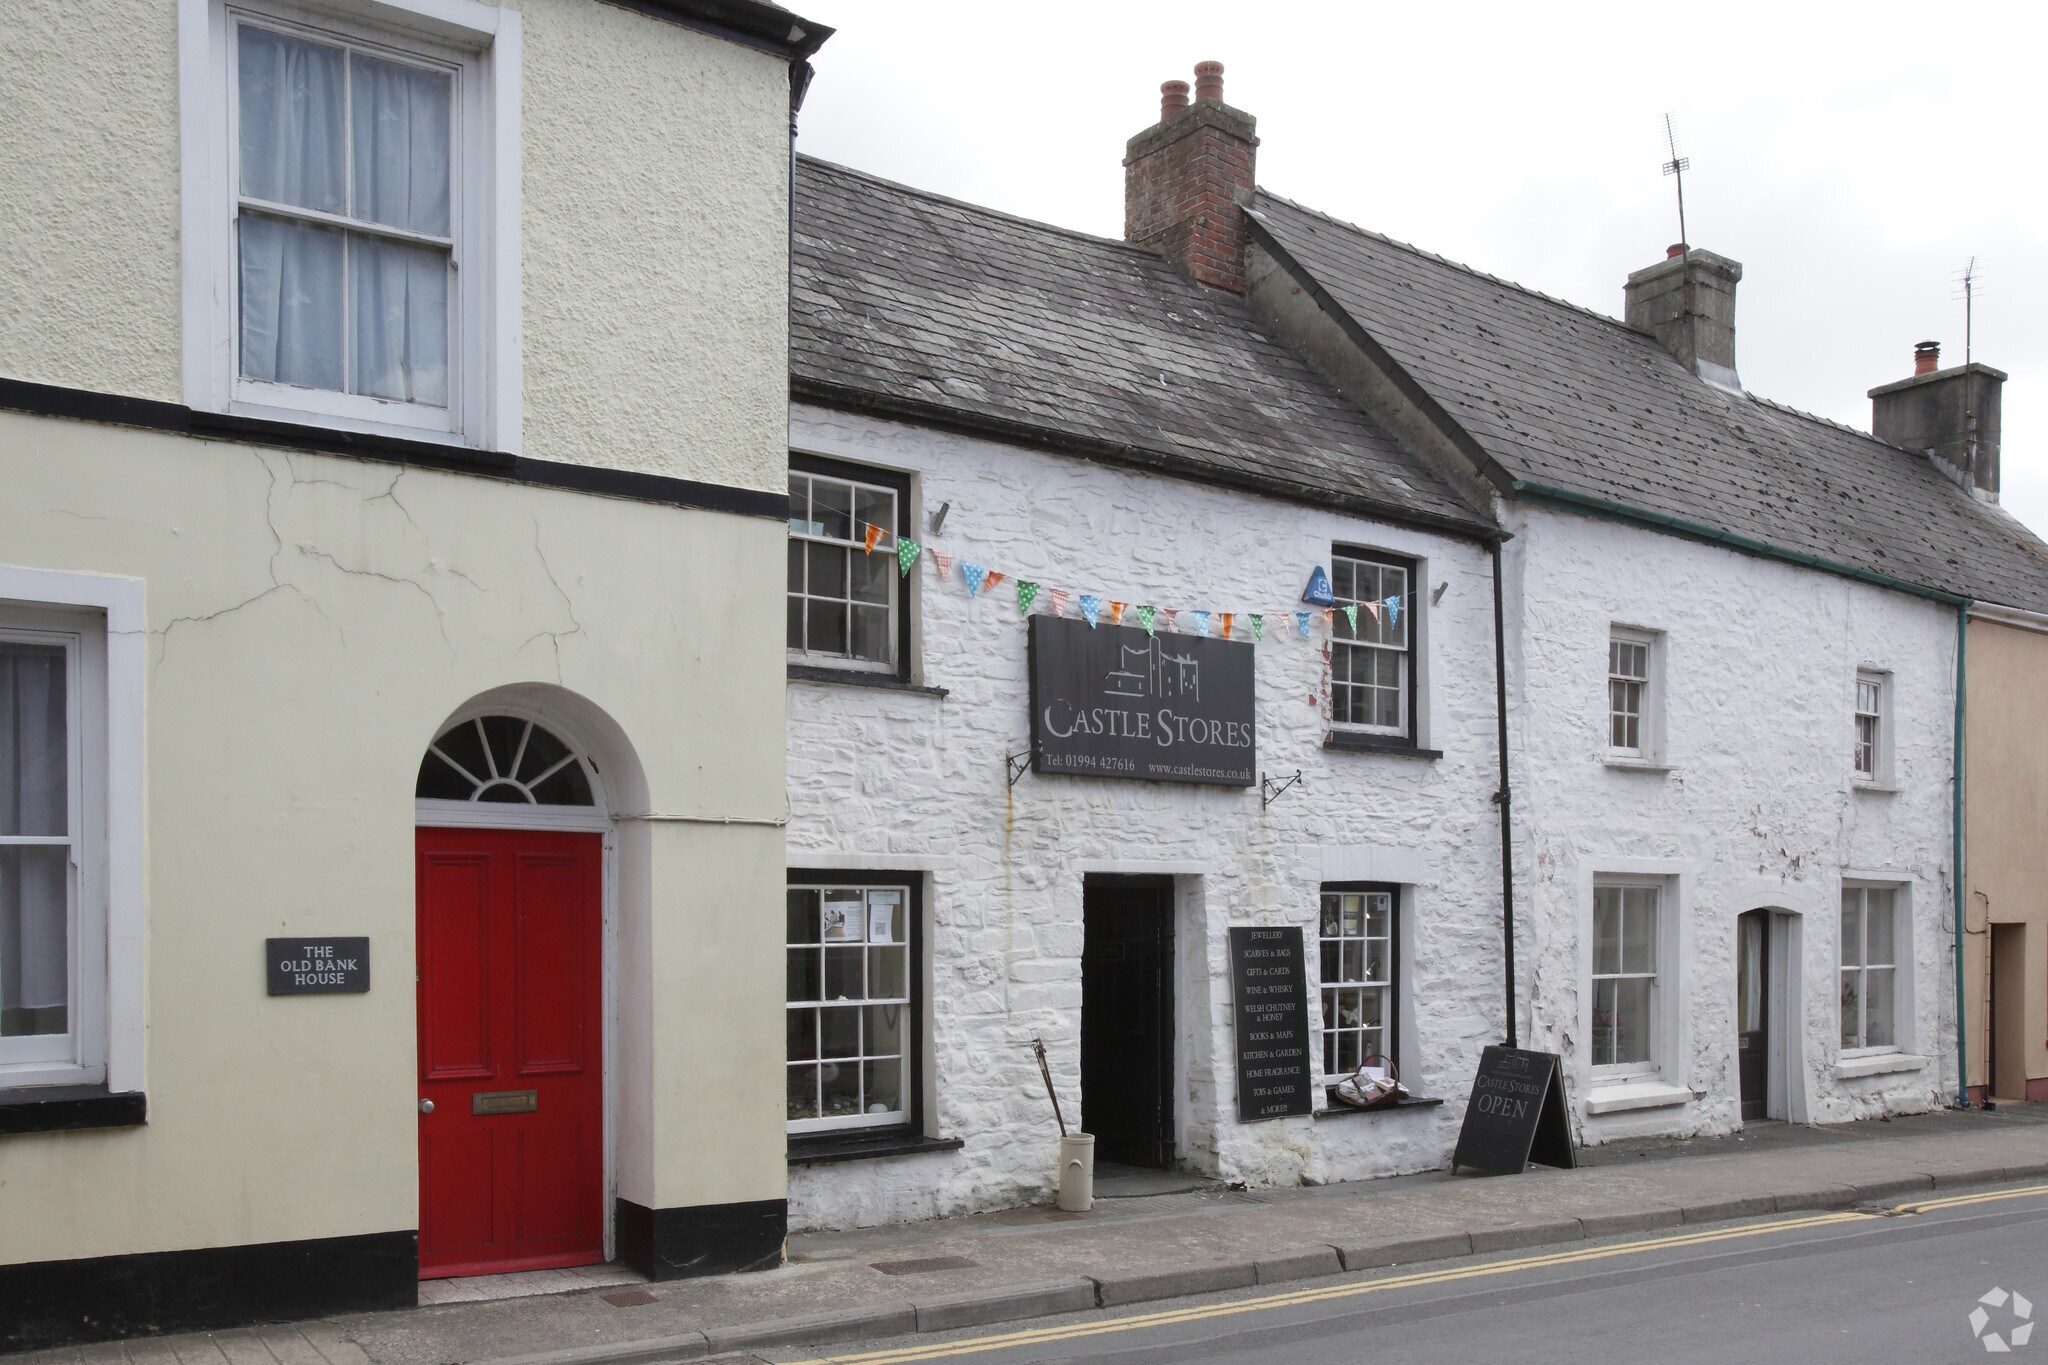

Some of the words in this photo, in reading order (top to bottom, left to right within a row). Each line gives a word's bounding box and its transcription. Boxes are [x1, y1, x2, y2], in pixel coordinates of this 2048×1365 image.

[1044, 698, 1151, 739] CASTLE
[1156, 708, 1251, 748] STORES
[1046, 753, 1063, 767] Tel:
[1065, 754, 1097, 768] 01994
[1099, 756, 1135, 771] 427616
[1148, 763, 1251, 780] www.castlestores.co.uk
[1251, 931, 1284, 941] JEWELLERY
[303, 946, 334, 958] THE
[1243, 949, 1269, 958] SCARVES
[1276, 949, 1291, 957] BAGS
[280, 960, 312, 972] OLD
[315, 959, 358, 971] BANK
[1246, 967, 1262, 976] GIFTS
[1269, 967, 1291, 976] CARDS
[295, 972, 345, 985] HOUSE
[1245, 986, 1262, 995] WINE
[1268, 985, 1293, 994] WHISKY
[1244, 1004, 1265, 1013] WELSH
[1265, 1003, 1296, 1012] CHUTNEY
[1262, 1013, 1284, 1022] HONEY
[1249, 1031, 1269, 1041] BOOKS
[1276, 1030, 1294, 1039] MAPS
[1243, 1050, 1269, 1060] KITCHEN
[1275, 1048, 1302, 1058] GARDEN
[1246, 1069, 1264, 1078] HOME
[1264, 1066, 1301, 1077] FRAGRANCE
[1477, 1074, 1509, 1090] CASTLE
[1507, 1079, 1540, 1095] STORES
[1252, 1087, 1267, 1097] TOYS
[1267, 1088, 1272, 1096] &
[1272, 1085, 1295, 1095] GAMES
[1478, 1094, 1529, 1119] OPEN
